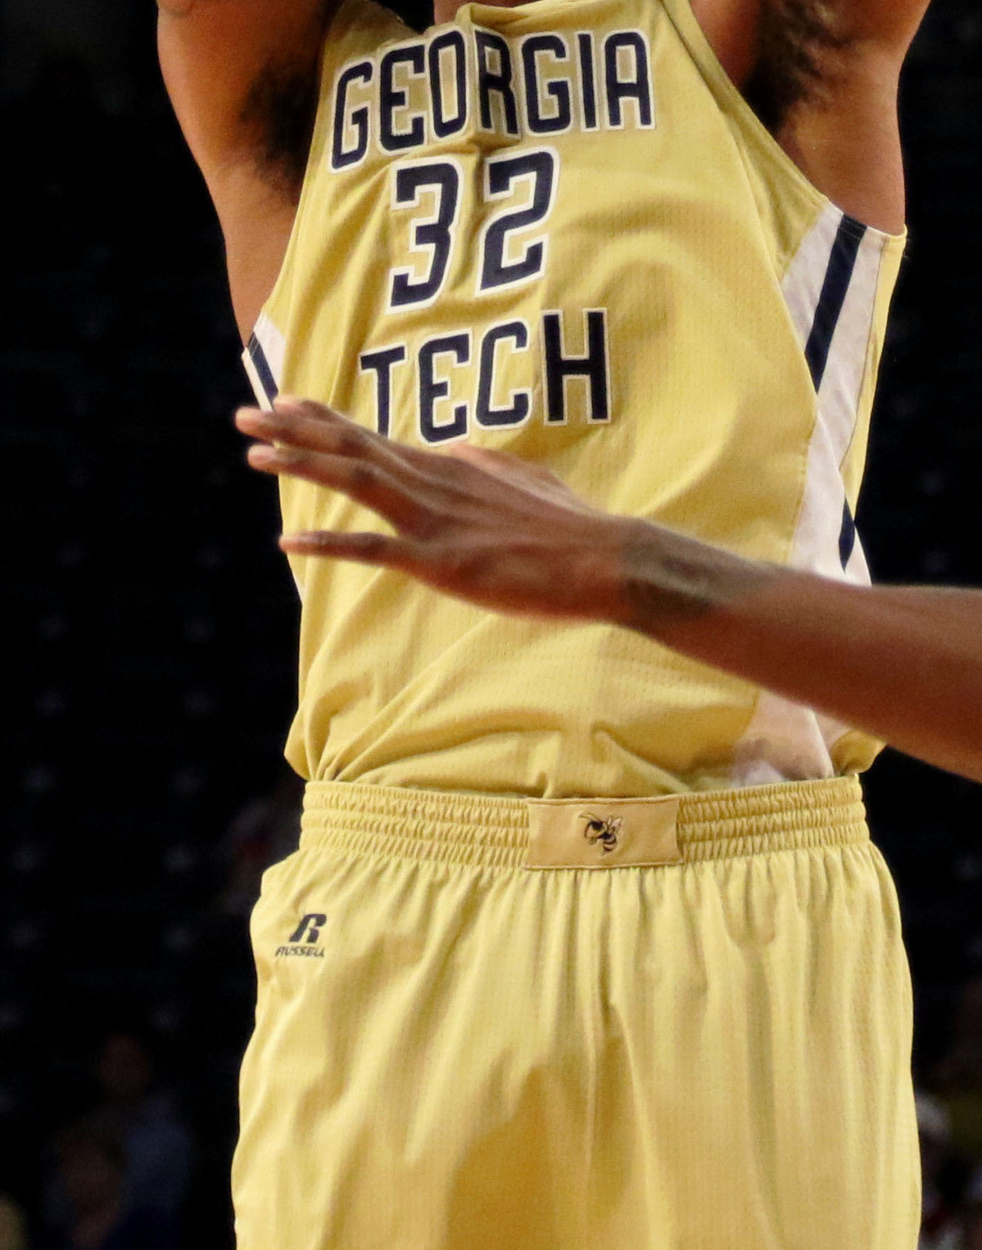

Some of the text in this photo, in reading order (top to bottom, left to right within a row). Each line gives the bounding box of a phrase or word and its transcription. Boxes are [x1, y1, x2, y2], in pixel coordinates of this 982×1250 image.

[328, 25, 656, 173] GEORGIA
[388, 145, 561, 314] 32
[358, 307, 612, 444] TECH
